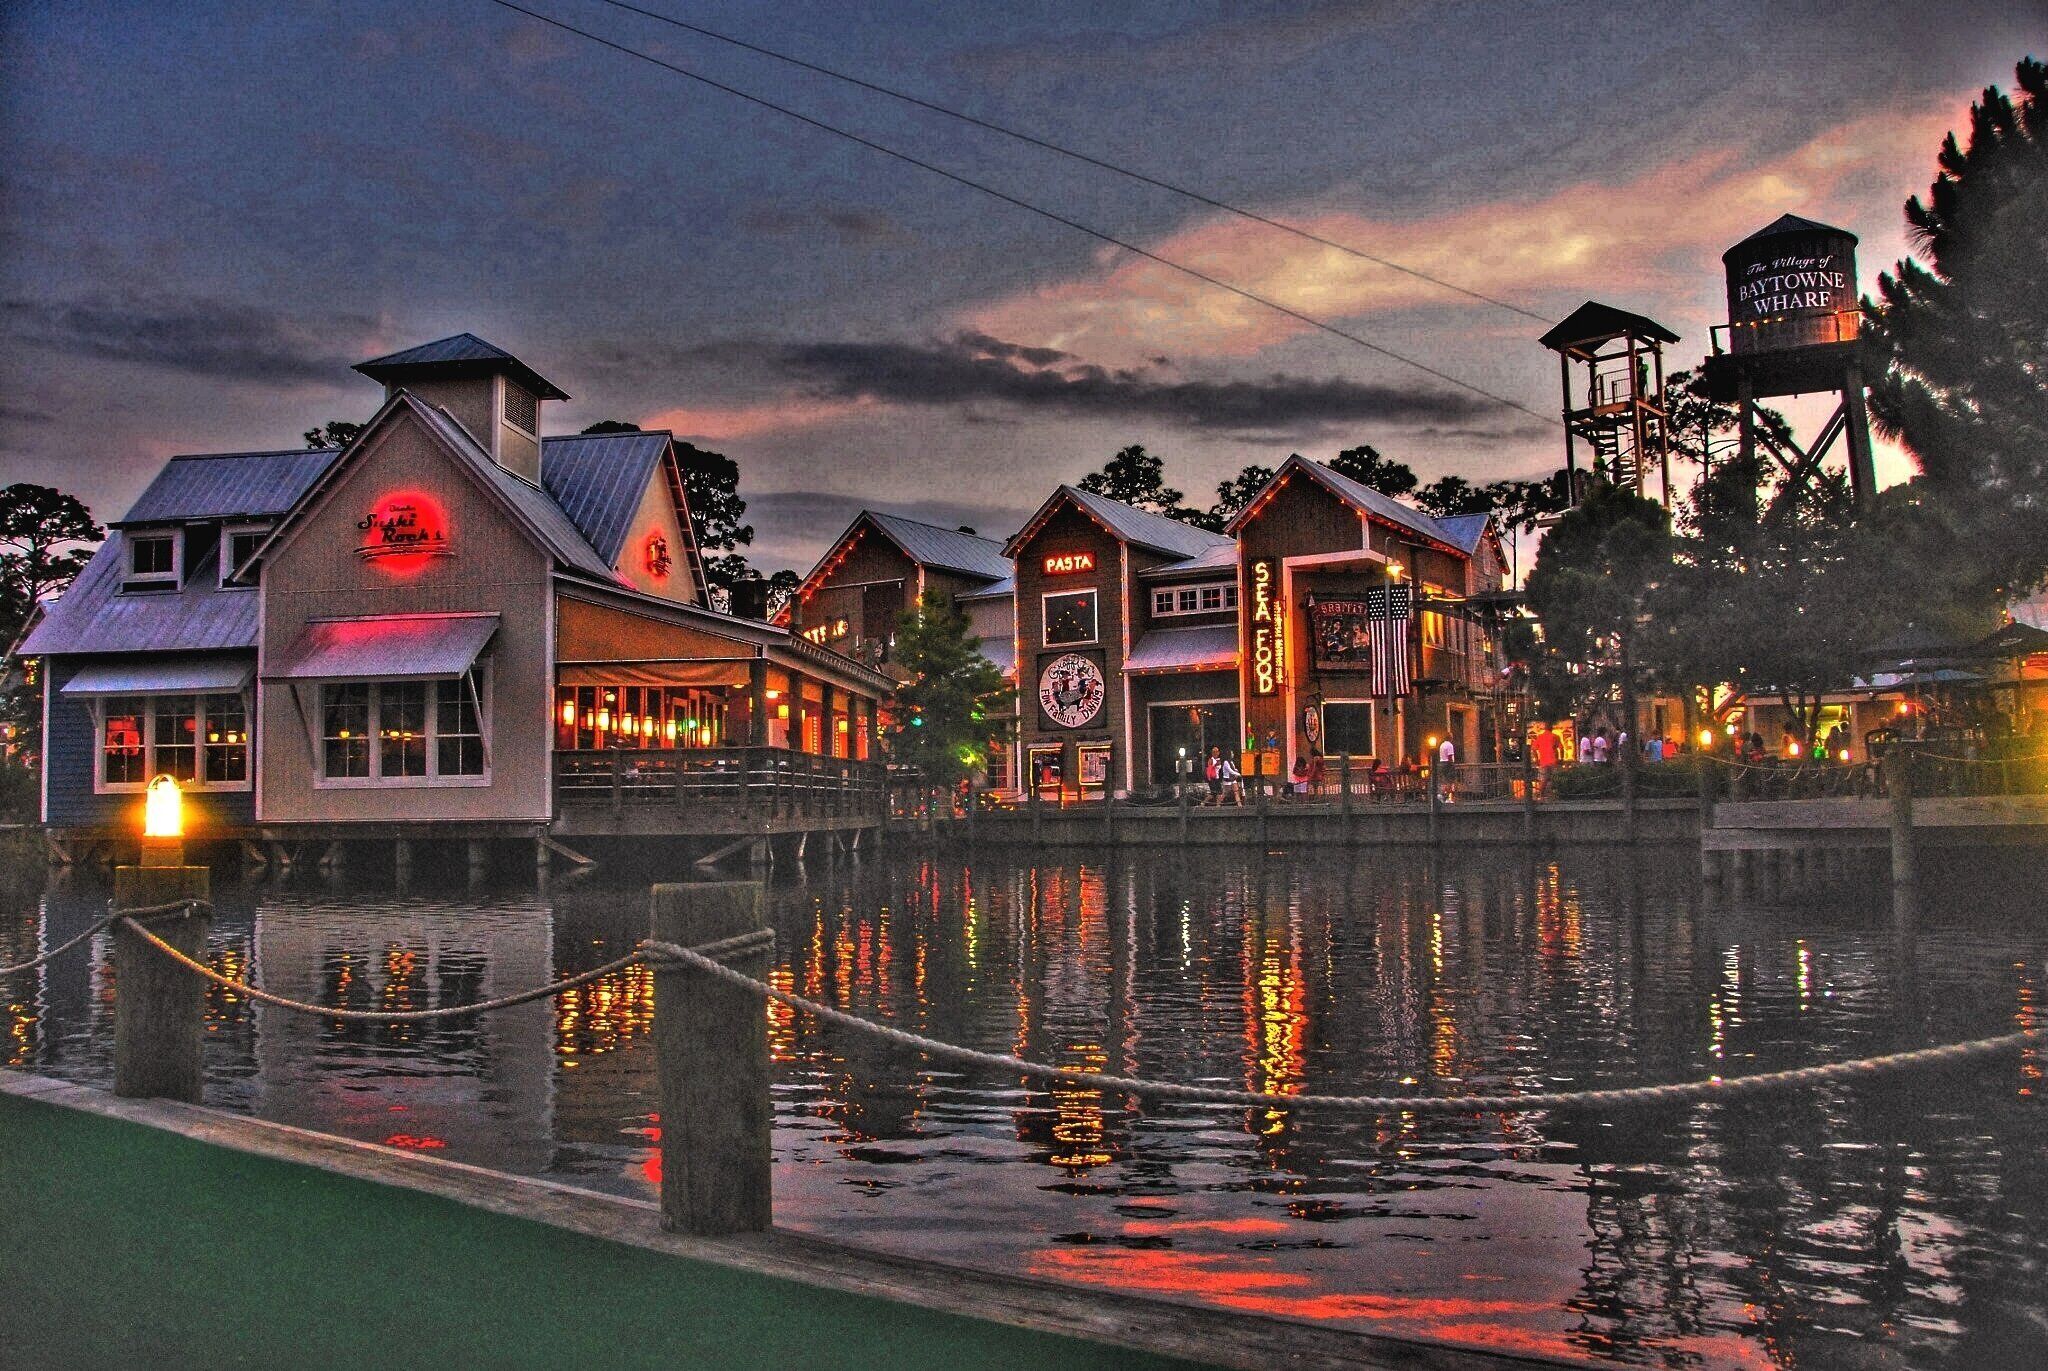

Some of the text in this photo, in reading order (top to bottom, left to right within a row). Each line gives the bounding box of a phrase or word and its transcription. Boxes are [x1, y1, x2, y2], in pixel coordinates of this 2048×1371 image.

[1747, 255, 1834, 276] The Village of
[1740, 272, 1845, 302] BAYTOWNE
[1754, 291, 1831, 315] WHARF
[1046, 555, 1093, 573] PASTA
[1041, 688, 1052, 706] FUN
